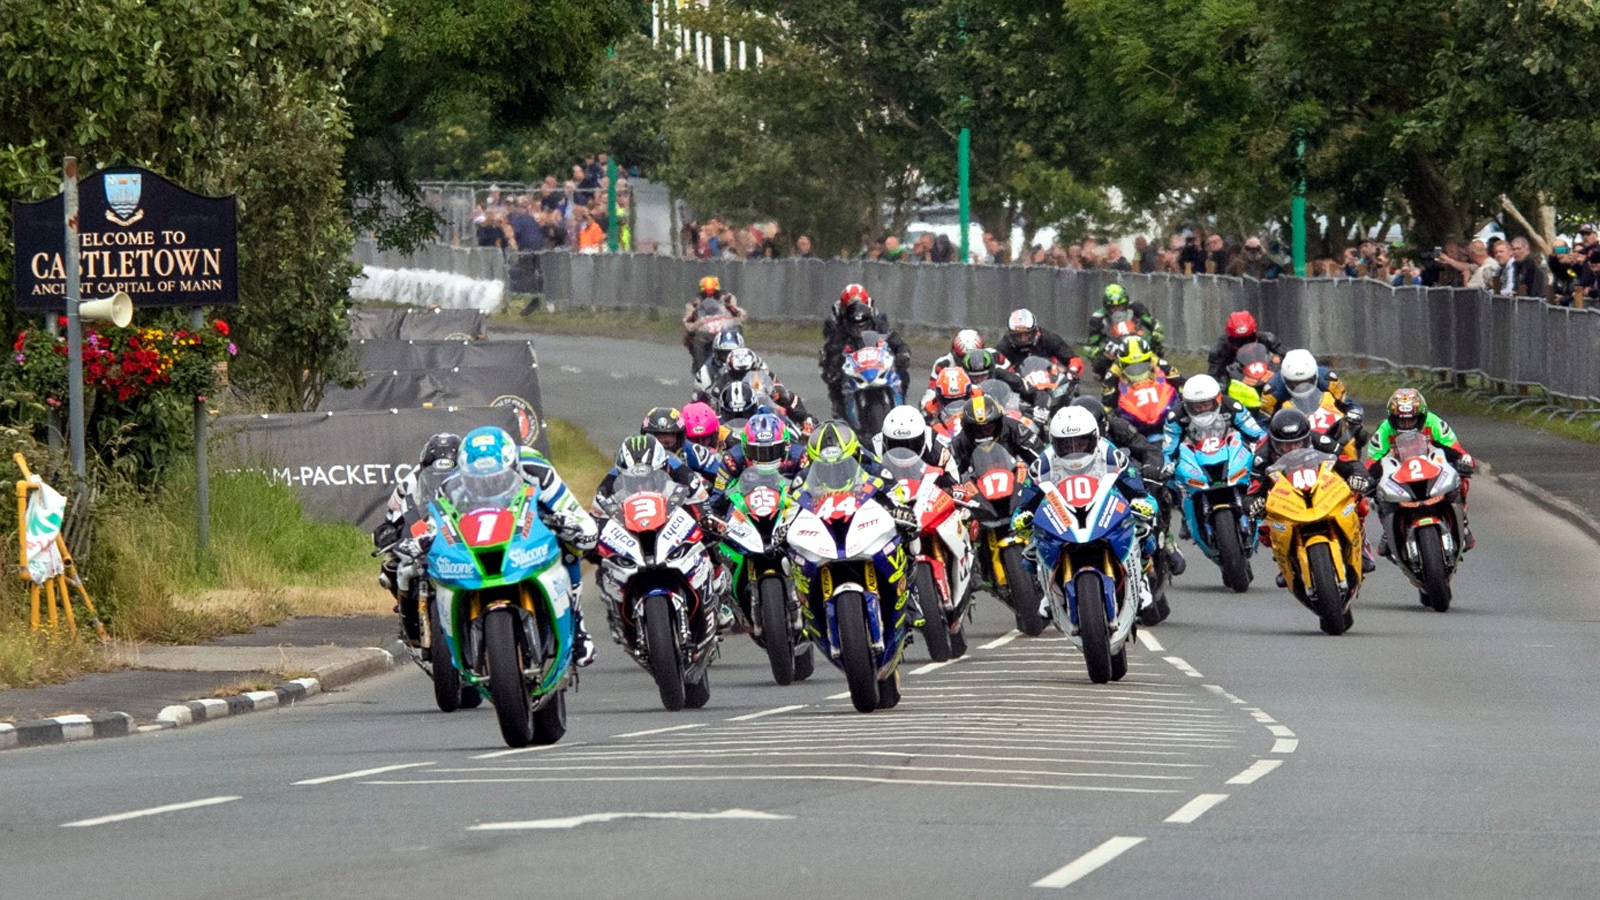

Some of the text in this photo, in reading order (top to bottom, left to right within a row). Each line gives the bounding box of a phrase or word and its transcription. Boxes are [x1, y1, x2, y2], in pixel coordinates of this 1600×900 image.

[78, 230, 186, 246] ELCOME TO
[32, 280, 222, 295] ANCINT CAPITAL OF MANN
[1133, 386, 1159, 407] 31
[1061, 425, 1081, 434] Arai
[1307, 412, 1331, 430] 12
[1201, 437, 1220, 453] 42
[213, 464, 421, 487] M-PACKET.C
[1292, 468, 1317, 490] 40
[1408, 459, 1424, 480] 2
[982, 472, 1008, 497] 17
[1066, 476, 1092, 502] 10
[631, 498, 657, 521] 3
[750, 490, 776, 509] 65
[815, 496, 858, 520] 44
[476, 513, 498, 542] 1
[610, 526, 636, 548] tyco
[661, 515, 685, 541] tyco
[436, 557, 475, 574] Silicone
[509, 544, 549, 568] Silicone
